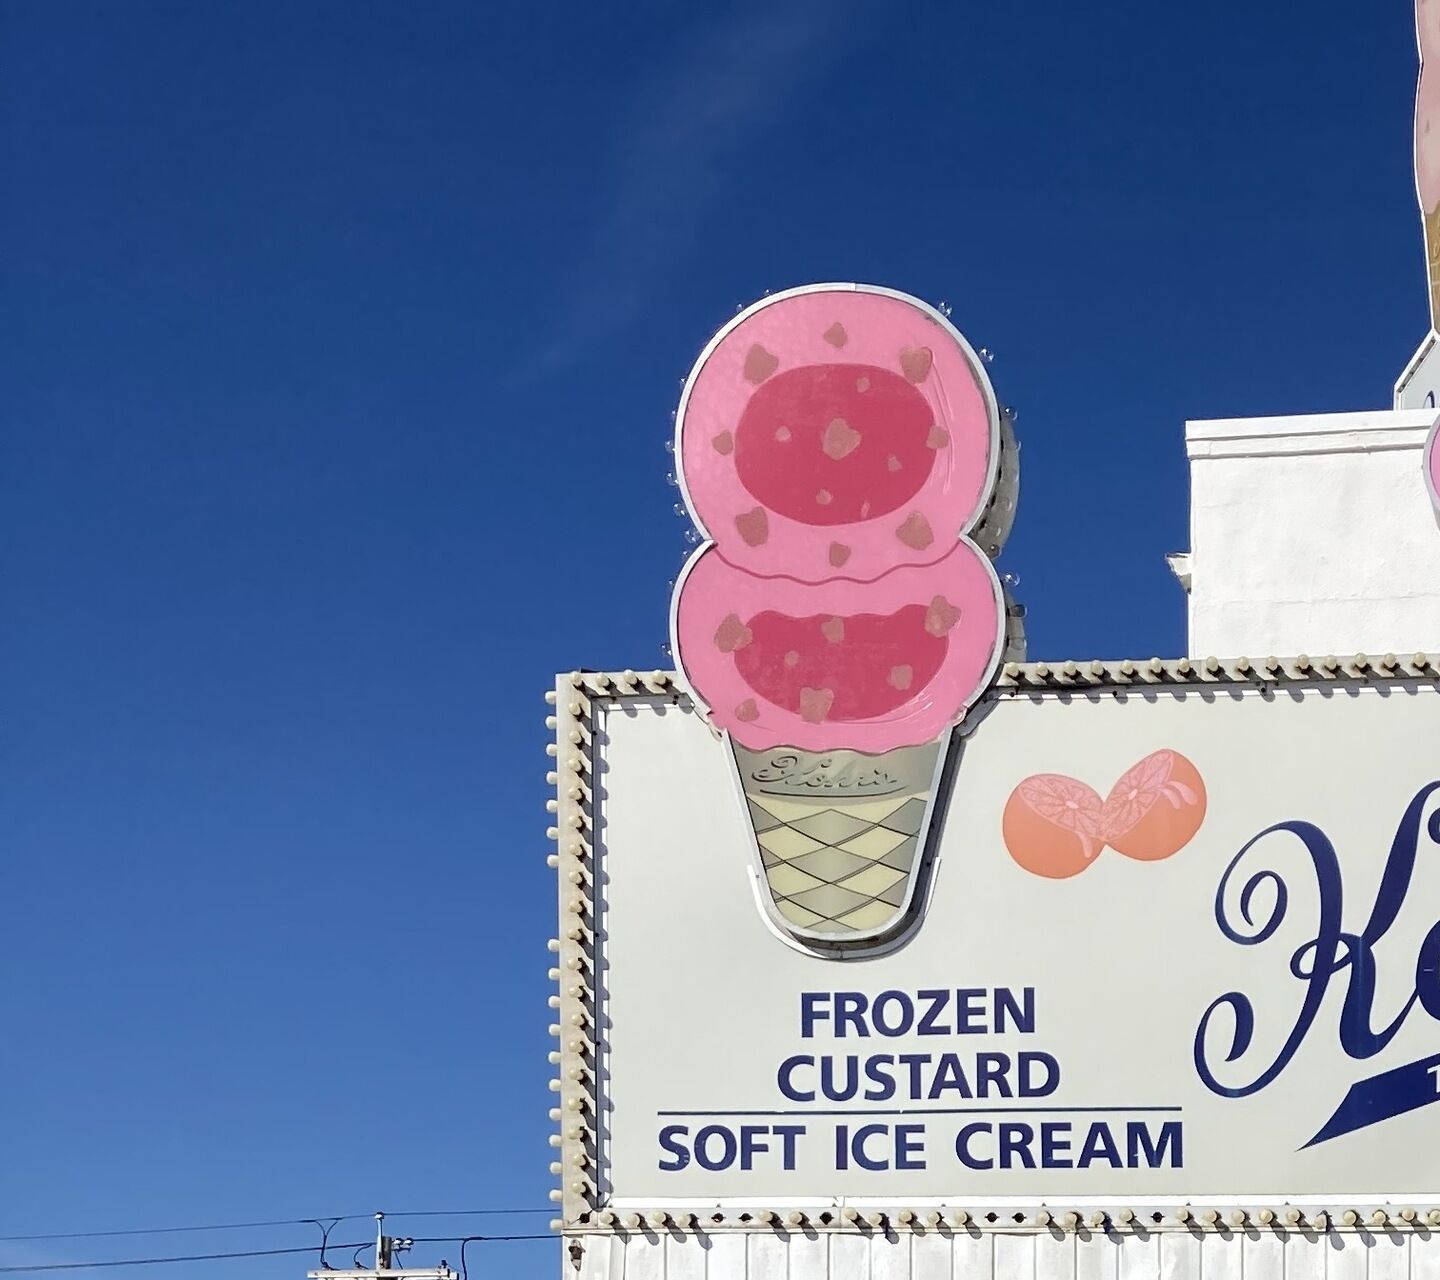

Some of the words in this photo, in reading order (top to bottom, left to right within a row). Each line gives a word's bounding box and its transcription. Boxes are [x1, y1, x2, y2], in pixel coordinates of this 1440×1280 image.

[802, 988, 1035, 1038] FROZEN
[777, 1052, 1060, 1102] CUSTARD
[658, 1125, 806, 1172] SOFT
[835, 1124, 927, 1171] ICE
[955, 1122, 1184, 1169] CREAM
